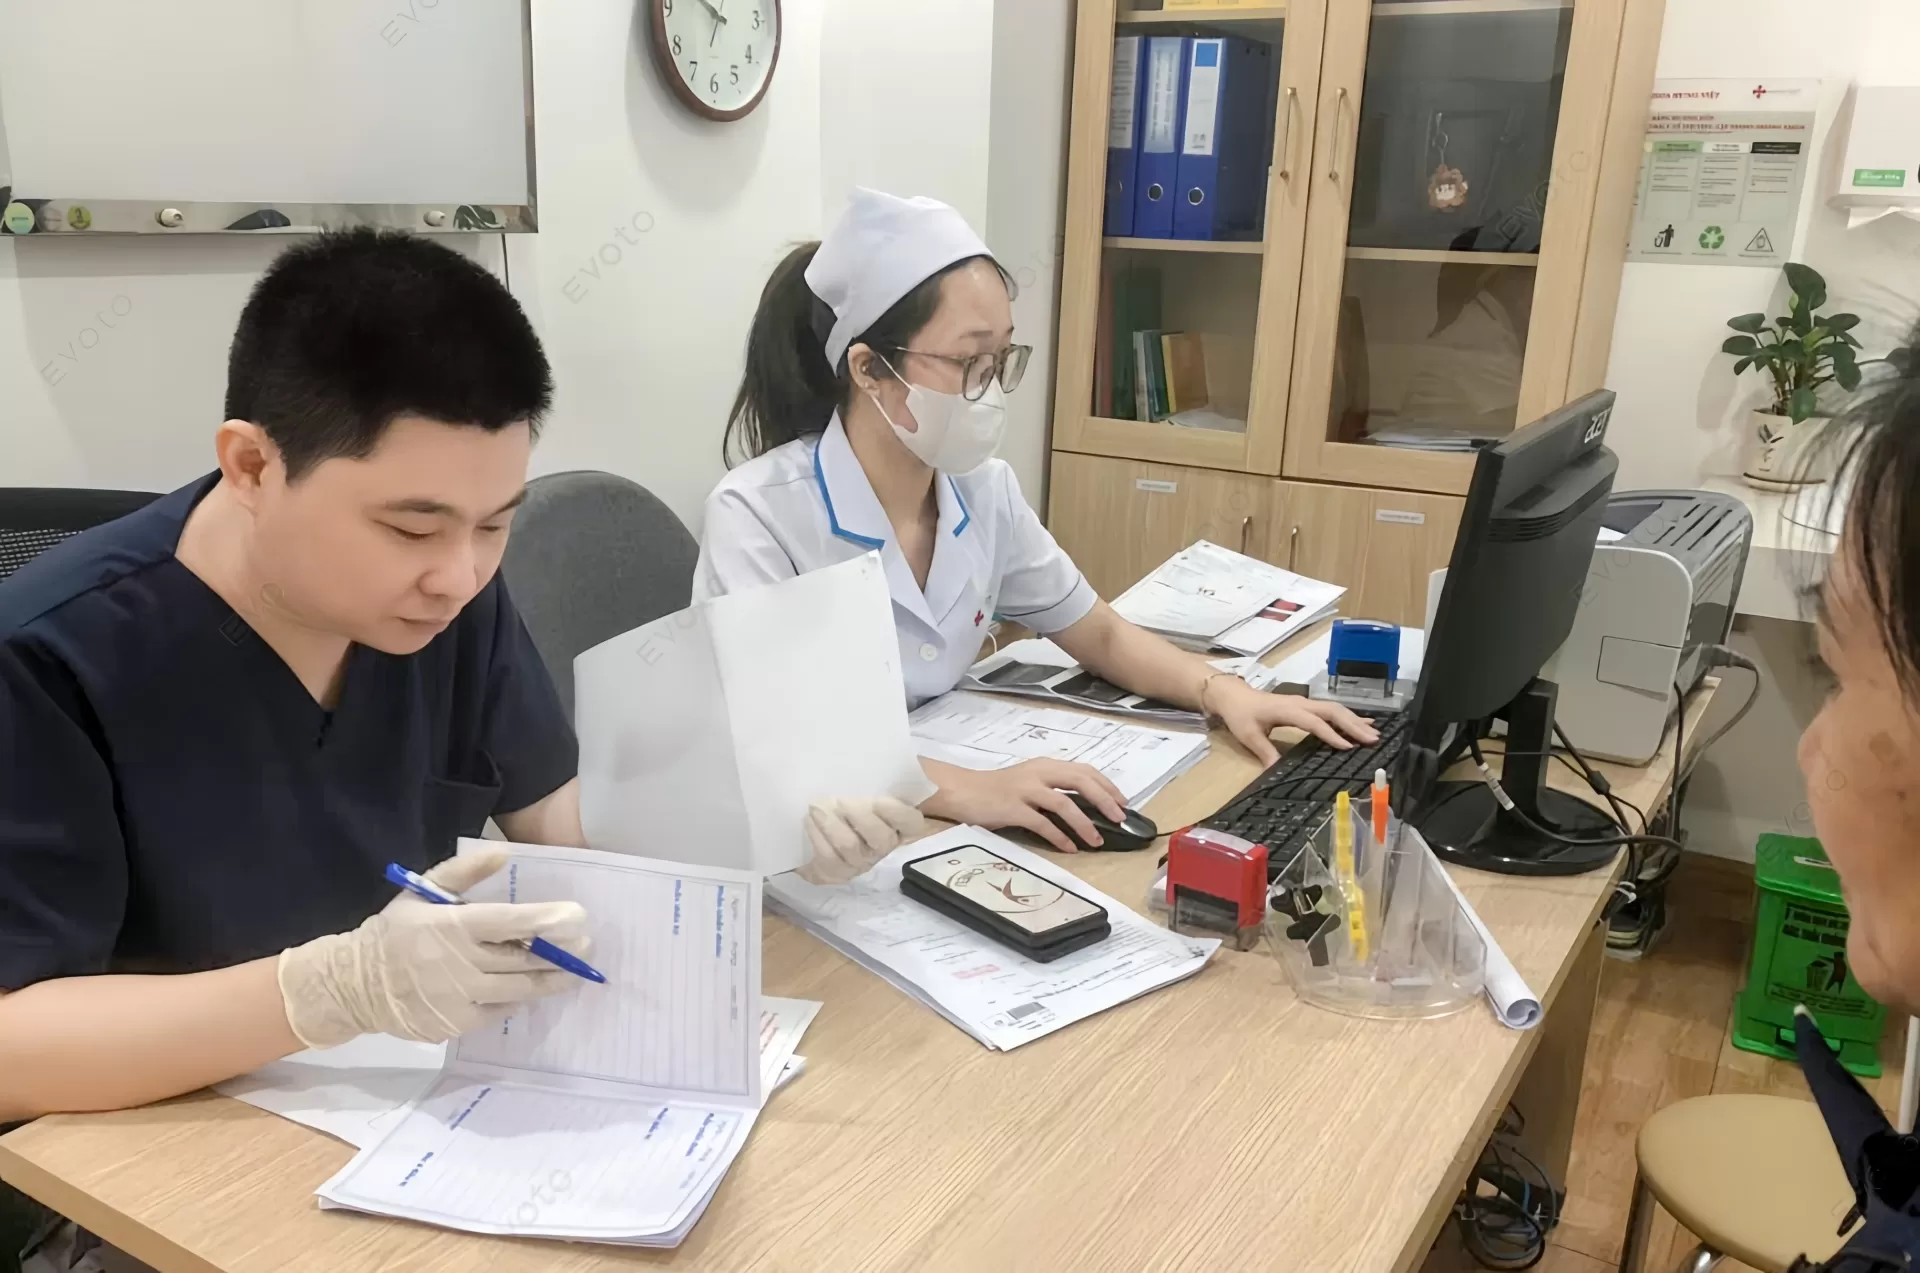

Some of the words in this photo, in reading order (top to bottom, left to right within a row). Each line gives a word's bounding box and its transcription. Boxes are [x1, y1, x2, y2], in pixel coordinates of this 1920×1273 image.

[663, 0, 673, 18] 9
[752, 10, 760, 31] 3
[672, 34, 682, 56] 8
[744, 43, 753, 64] 4
[688, 60, 699, 82] 7
[729, 64, 739, 86] 5
[709, 72, 719, 94] 6
